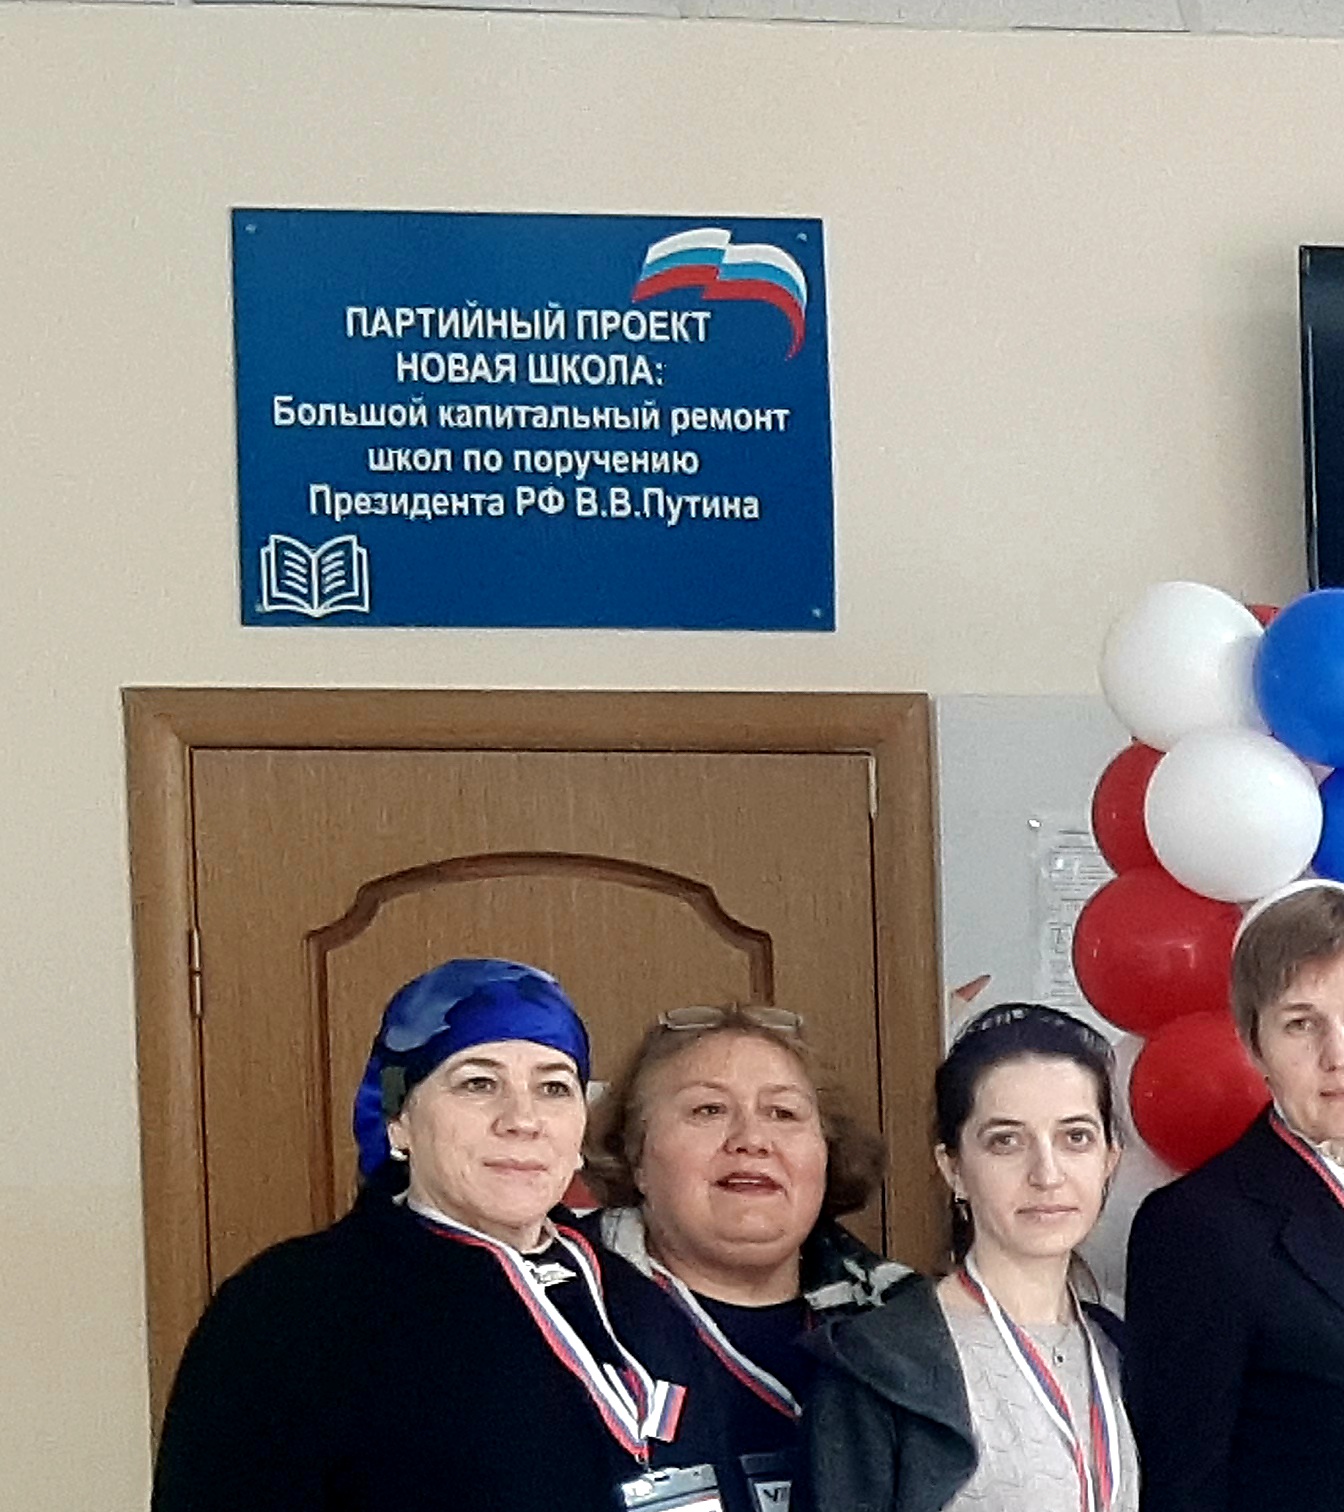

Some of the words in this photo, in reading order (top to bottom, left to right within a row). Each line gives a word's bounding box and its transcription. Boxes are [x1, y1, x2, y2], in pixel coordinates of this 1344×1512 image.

[347, 299, 565, 340] ПАРТИЙНЫЙ
[577, 309, 711, 343] ПРОЕКТ
[396, 351, 516, 383] НОВАЯ
[528, 353, 664, 386] ШКОЛА:
[273, 392, 428, 428] Большой
[438, 399, 660, 431] капитальный
[671, 407, 790, 437] ремонт
[368, 448, 453, 475] школ
[463, 448, 503, 474] по
[513, 449, 701, 482] поручению
[309, 483, 505, 522] Президента
[516, 485, 565, 516] РФ
[575, 486, 760, 527] В.В.Путина
